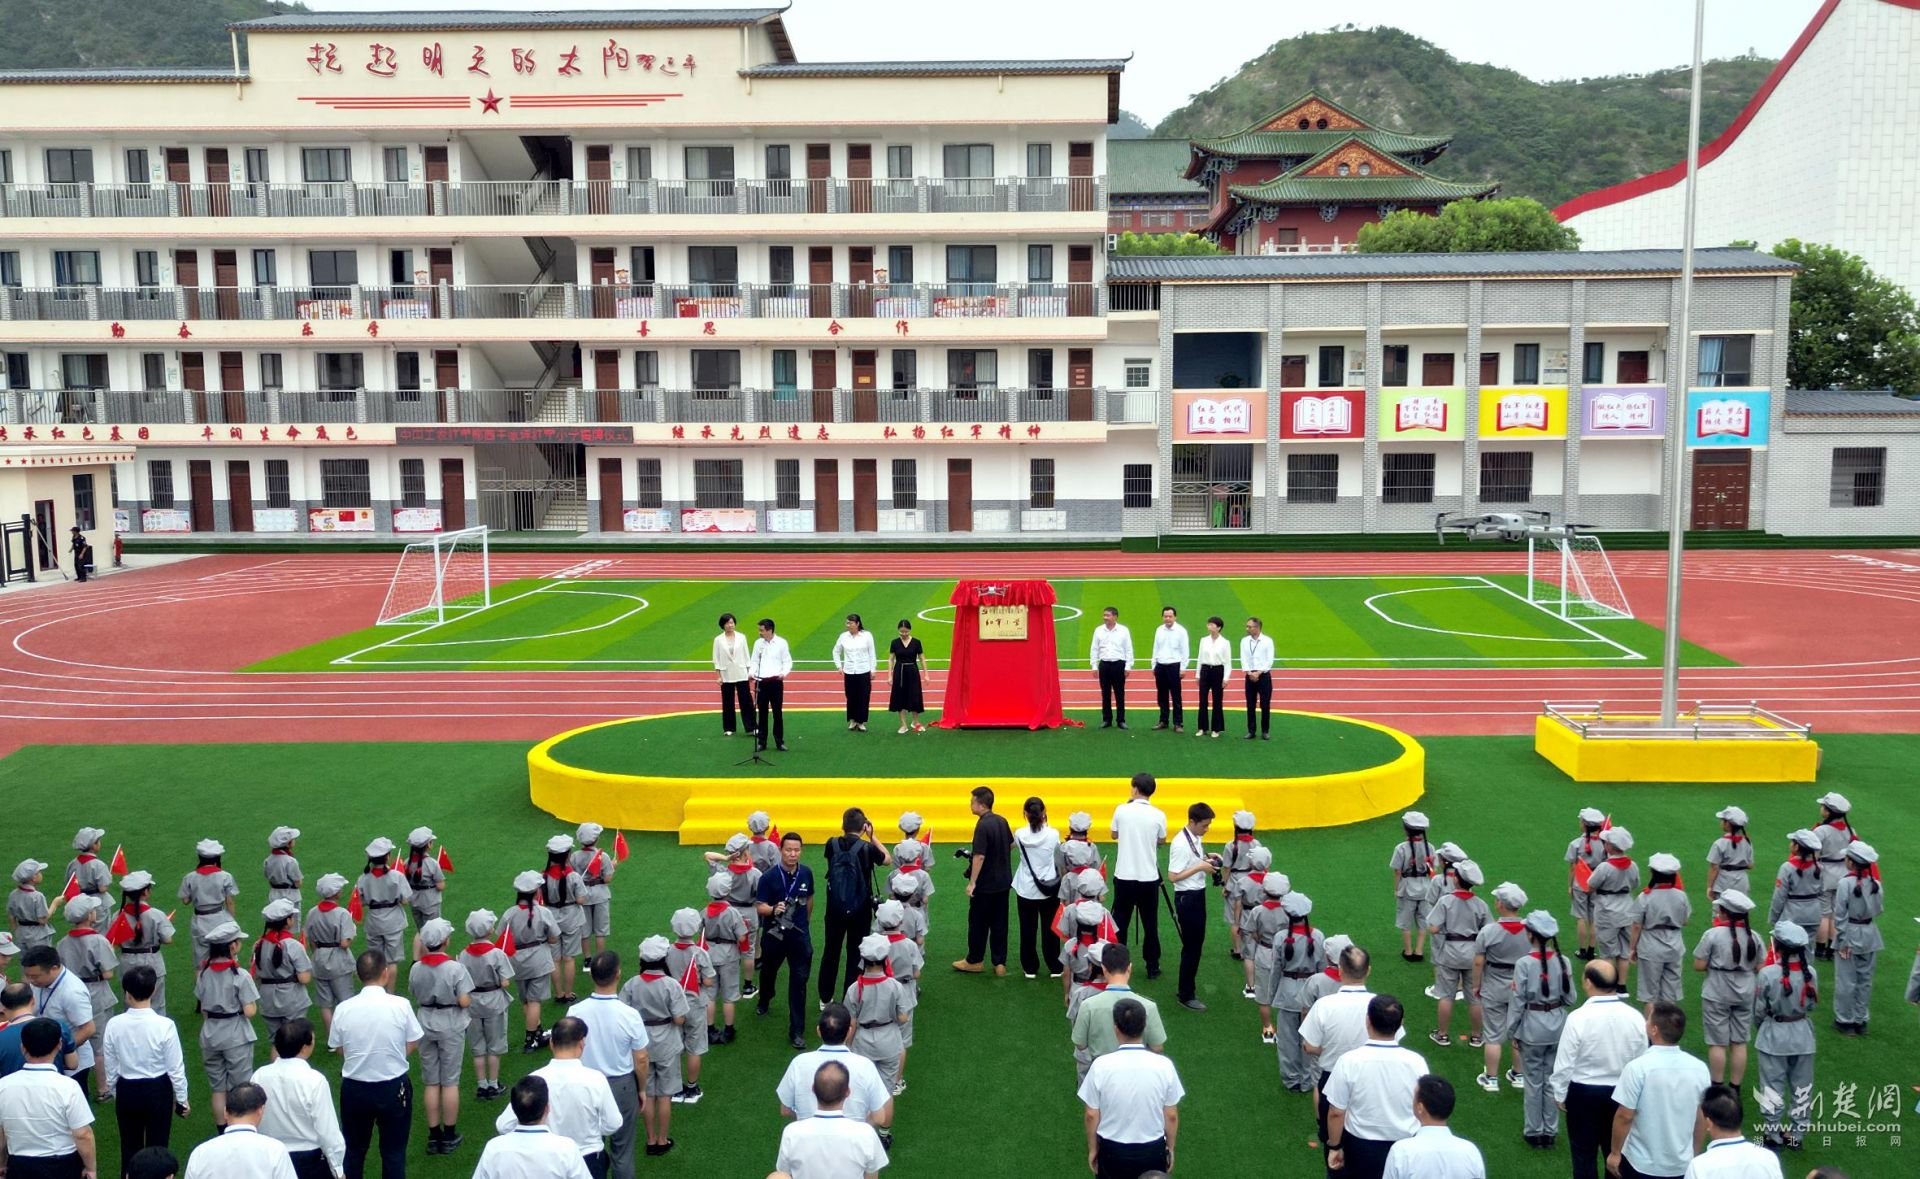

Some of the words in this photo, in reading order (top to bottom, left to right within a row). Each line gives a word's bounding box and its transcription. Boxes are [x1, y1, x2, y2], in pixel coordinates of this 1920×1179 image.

[306, 39, 629, 77] 托起明天的太阳
[111, 321, 192, 339] 勤奋
[302, 320, 380, 338] 乐学
[636, 318, 717, 337] 善思
[827, 318, 910, 336] 合作
[1197, 405, 1216, 414] 红色
[672, 424, 830, 441] 继承先烈遗志
[884, 423, 1042, 440] 弘扬红军精神
